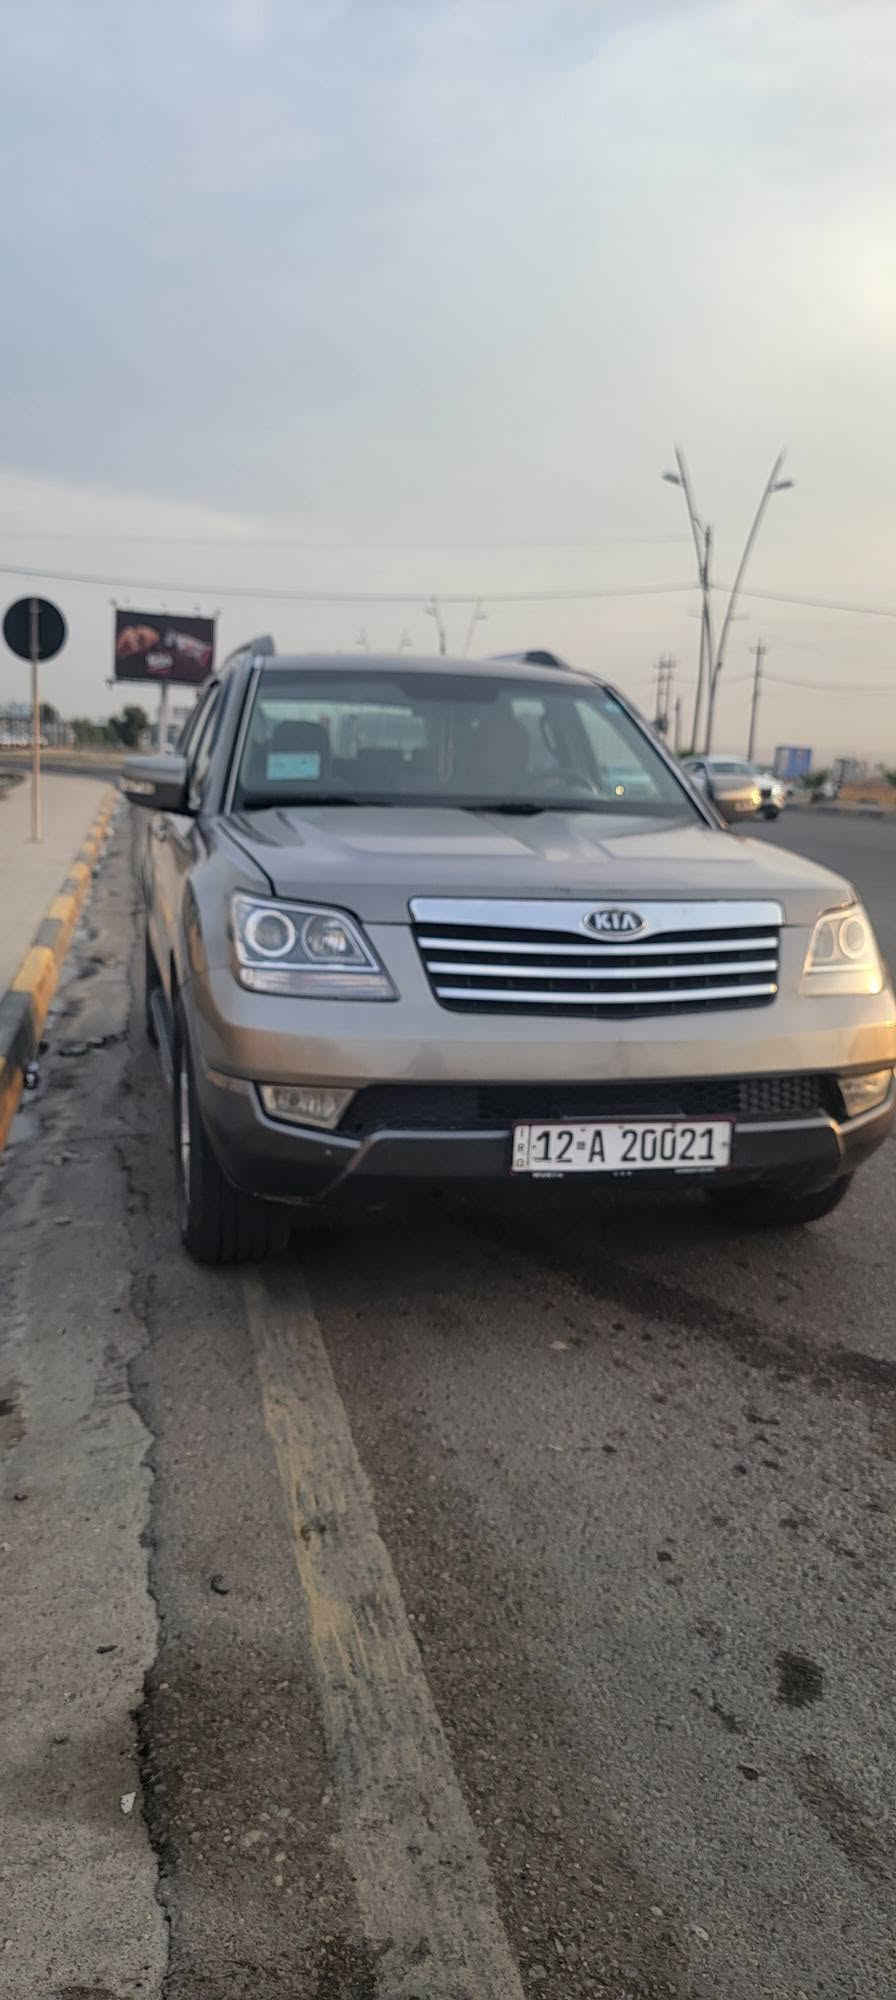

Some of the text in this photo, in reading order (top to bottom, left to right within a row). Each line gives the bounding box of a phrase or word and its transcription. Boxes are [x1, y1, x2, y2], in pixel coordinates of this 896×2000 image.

[594, 912, 637, 930] KIA
[535, 1128, 715, 1163] 12 A 20021
